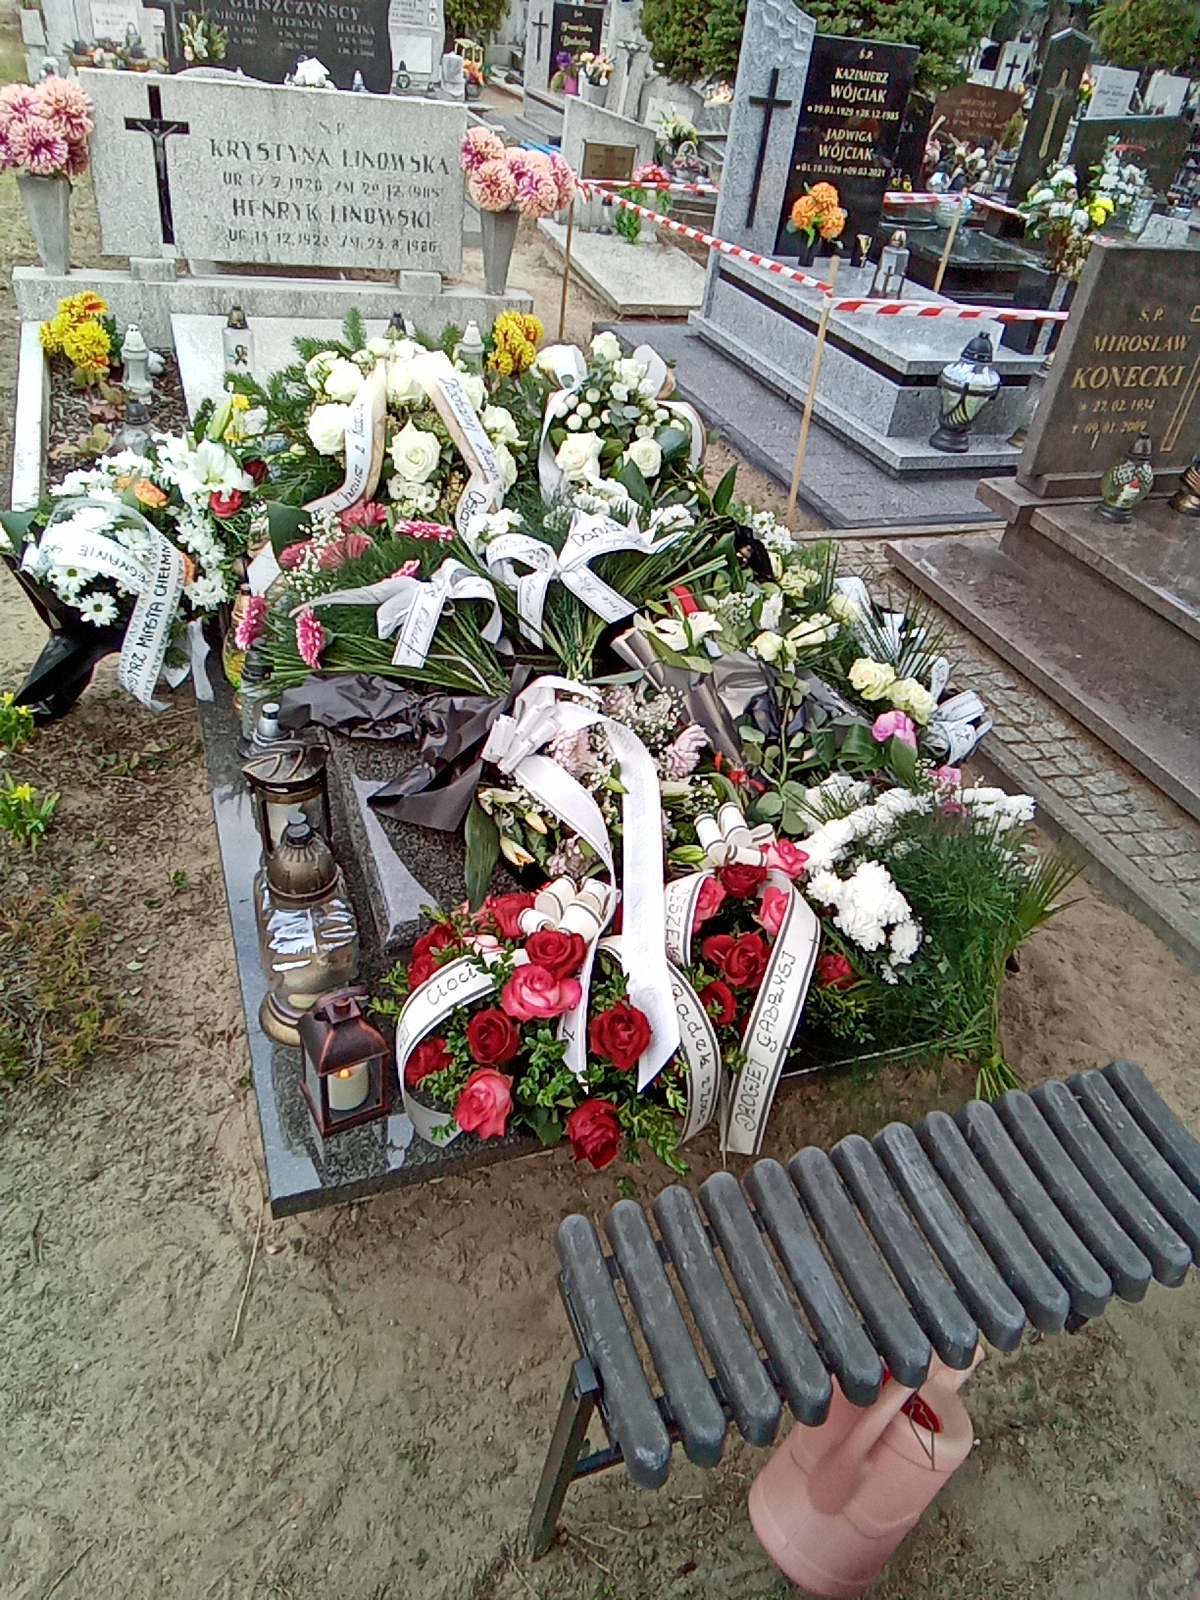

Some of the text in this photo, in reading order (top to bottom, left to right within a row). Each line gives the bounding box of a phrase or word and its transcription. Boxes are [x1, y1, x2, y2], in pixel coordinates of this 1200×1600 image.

[834, 67, 890, 84] KAZIMIERZ
[830, 82, 888, 103] WÓJCIAK
[824, 127, 873, 143] JADWIGA
[210, 138, 449, 175] KRYSTYNA LINOWSKA
[818, 142, 875, 161] WÓJCIAK
[232, 198, 433, 228] HENRYK LINOWSKI
[1070, 365, 1186, 390] KONECKI
